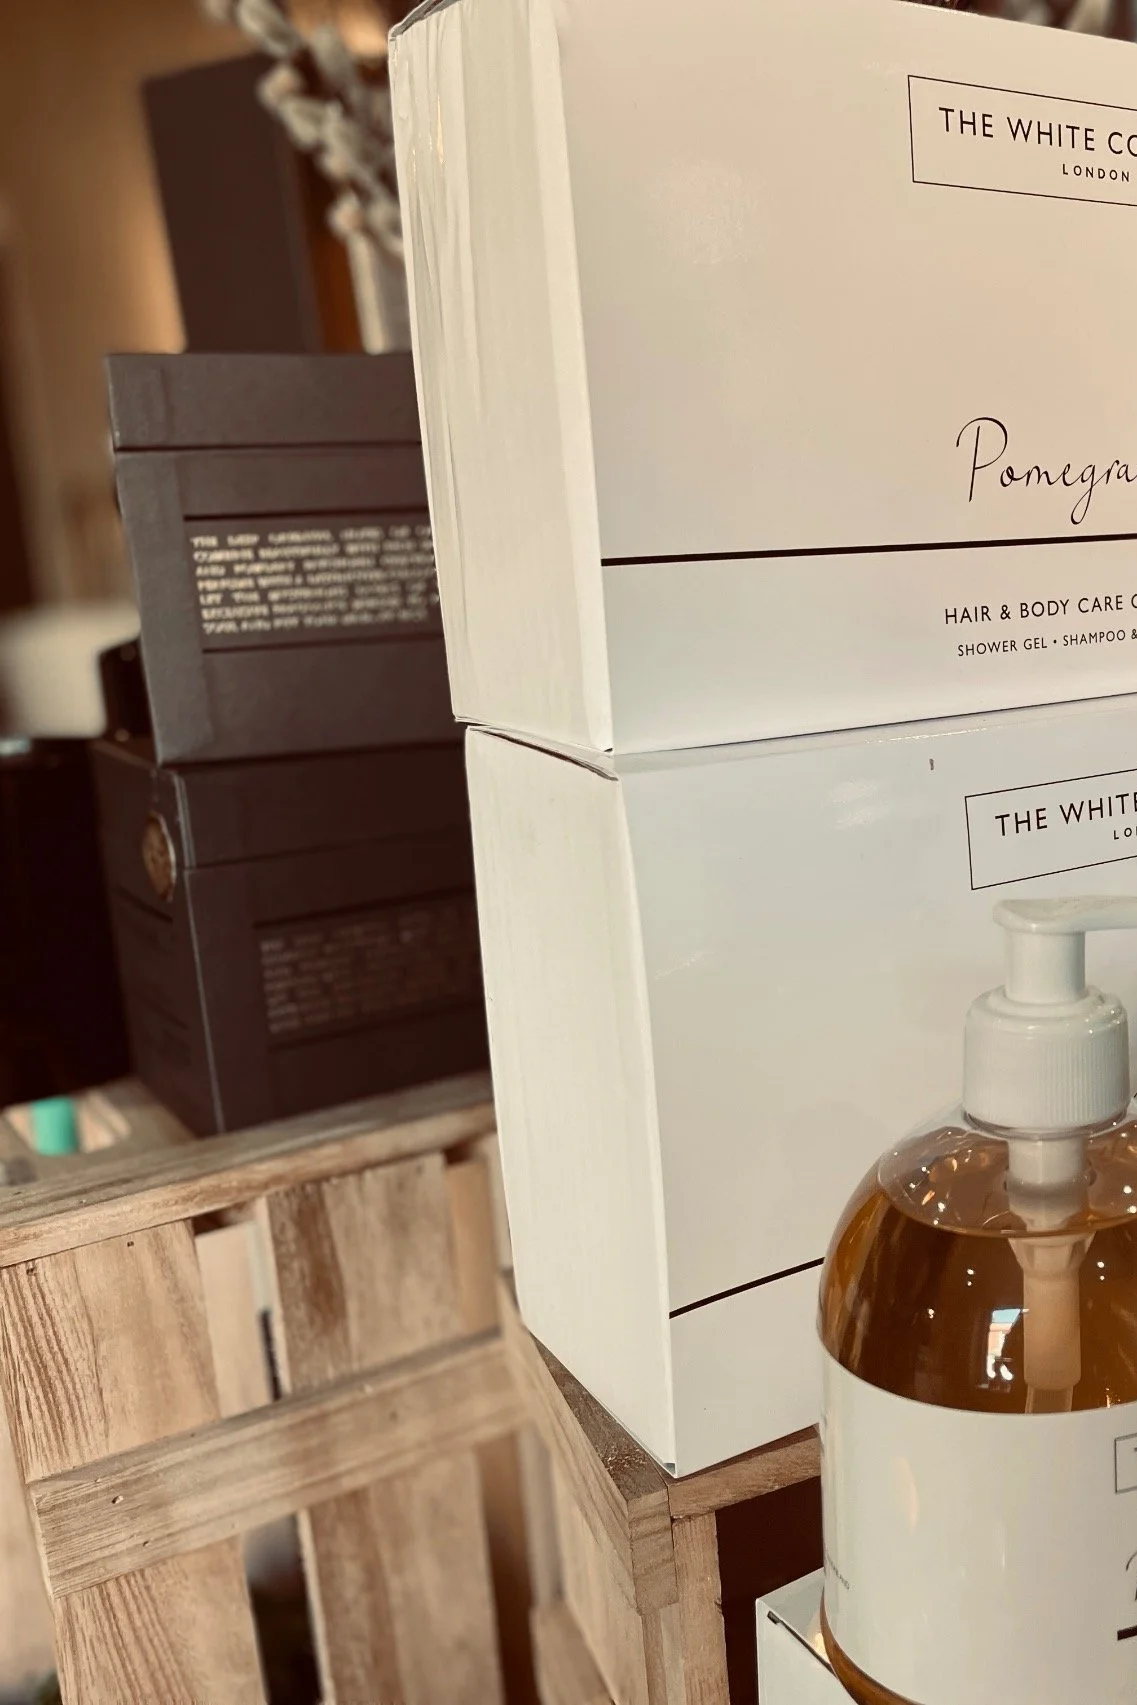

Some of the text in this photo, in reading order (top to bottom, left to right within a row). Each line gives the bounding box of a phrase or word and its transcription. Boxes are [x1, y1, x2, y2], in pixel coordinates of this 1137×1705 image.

[938, 107, 994, 138] THE
[1006, 116, 1096, 151] WHITE
[1062, 163, 1130, 182] LONDON
[944, 606, 992, 625] HAIR
[1000, 604, 1011, 620] &
[1020, 599, 1070, 619] BODY
[1078, 595, 1124, 614] CARE
[957, 639, 1018, 657] SHOWER
[1023, 637, 1048, 650] GEL
[1063, 629, 1126, 647] SHAMPOO
[995, 807, 1048, 837] THE
